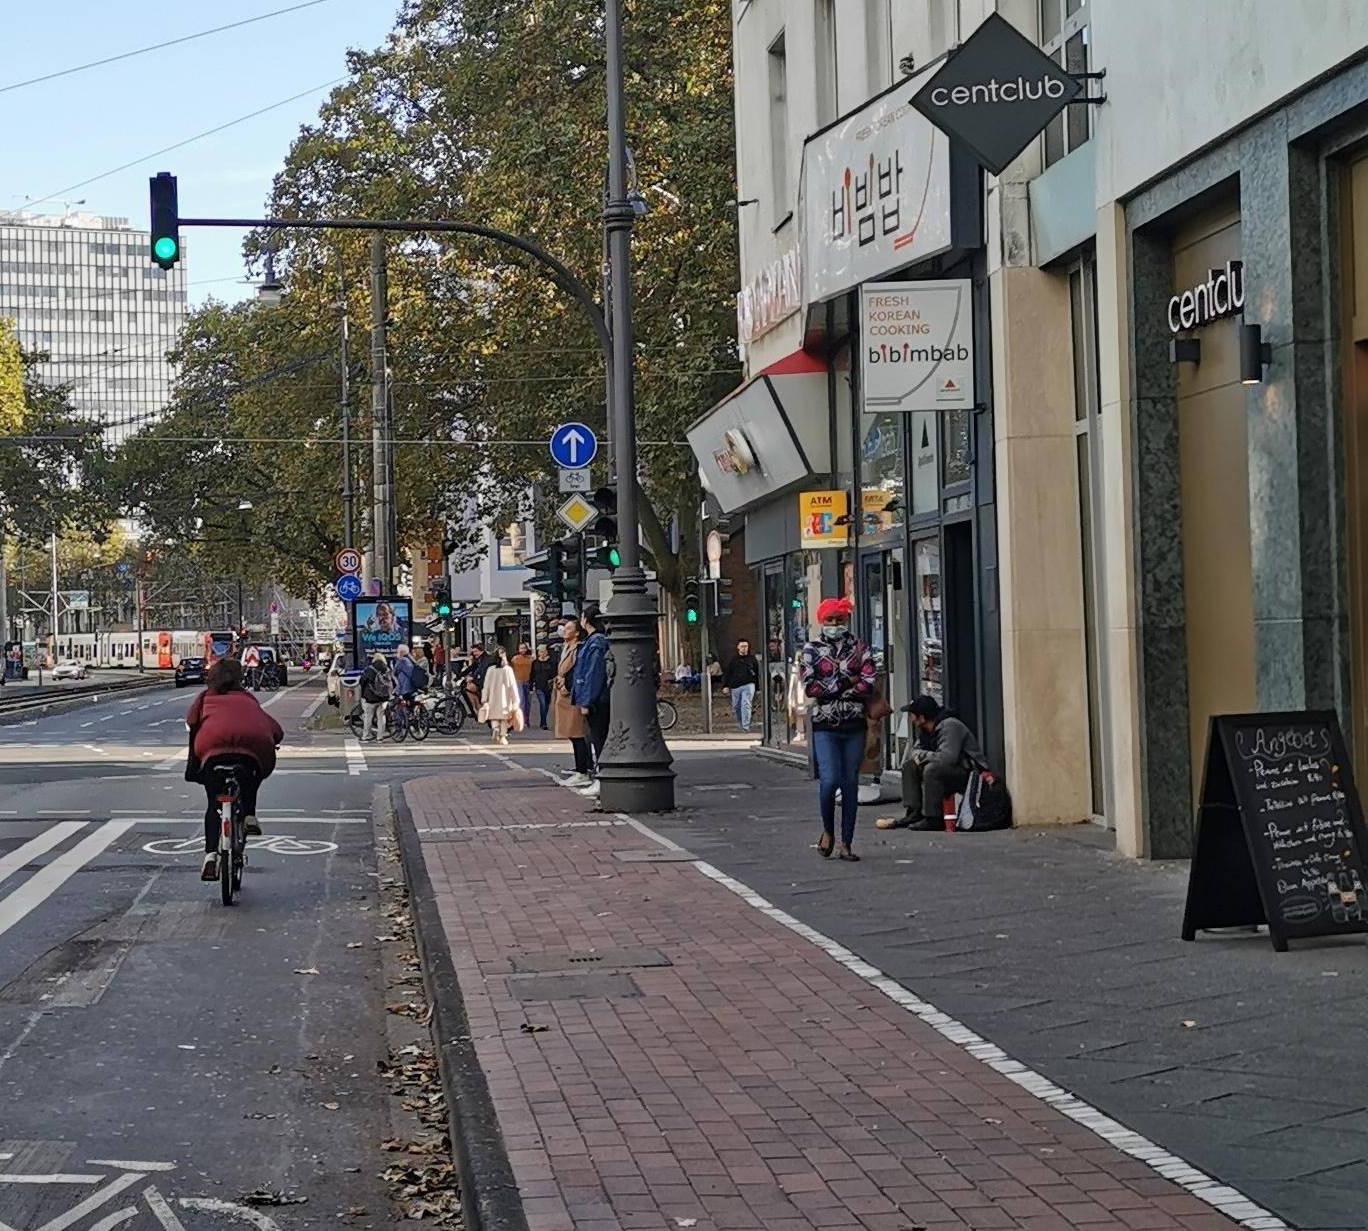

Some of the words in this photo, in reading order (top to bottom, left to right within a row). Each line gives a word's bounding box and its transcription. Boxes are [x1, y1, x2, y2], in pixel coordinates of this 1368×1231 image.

[931, 75, 1065, 106] centclub
[832, 149, 904, 247] 비빔밥
[868, 296, 910, 307] FRESH
[869, 310, 921, 322] KOREAN
[870, 324, 931, 336] COOKING
[869, 343, 969, 364] bibimbab
[810, 496, 832, 505] ATM
[342, 555, 357, 568] 30
